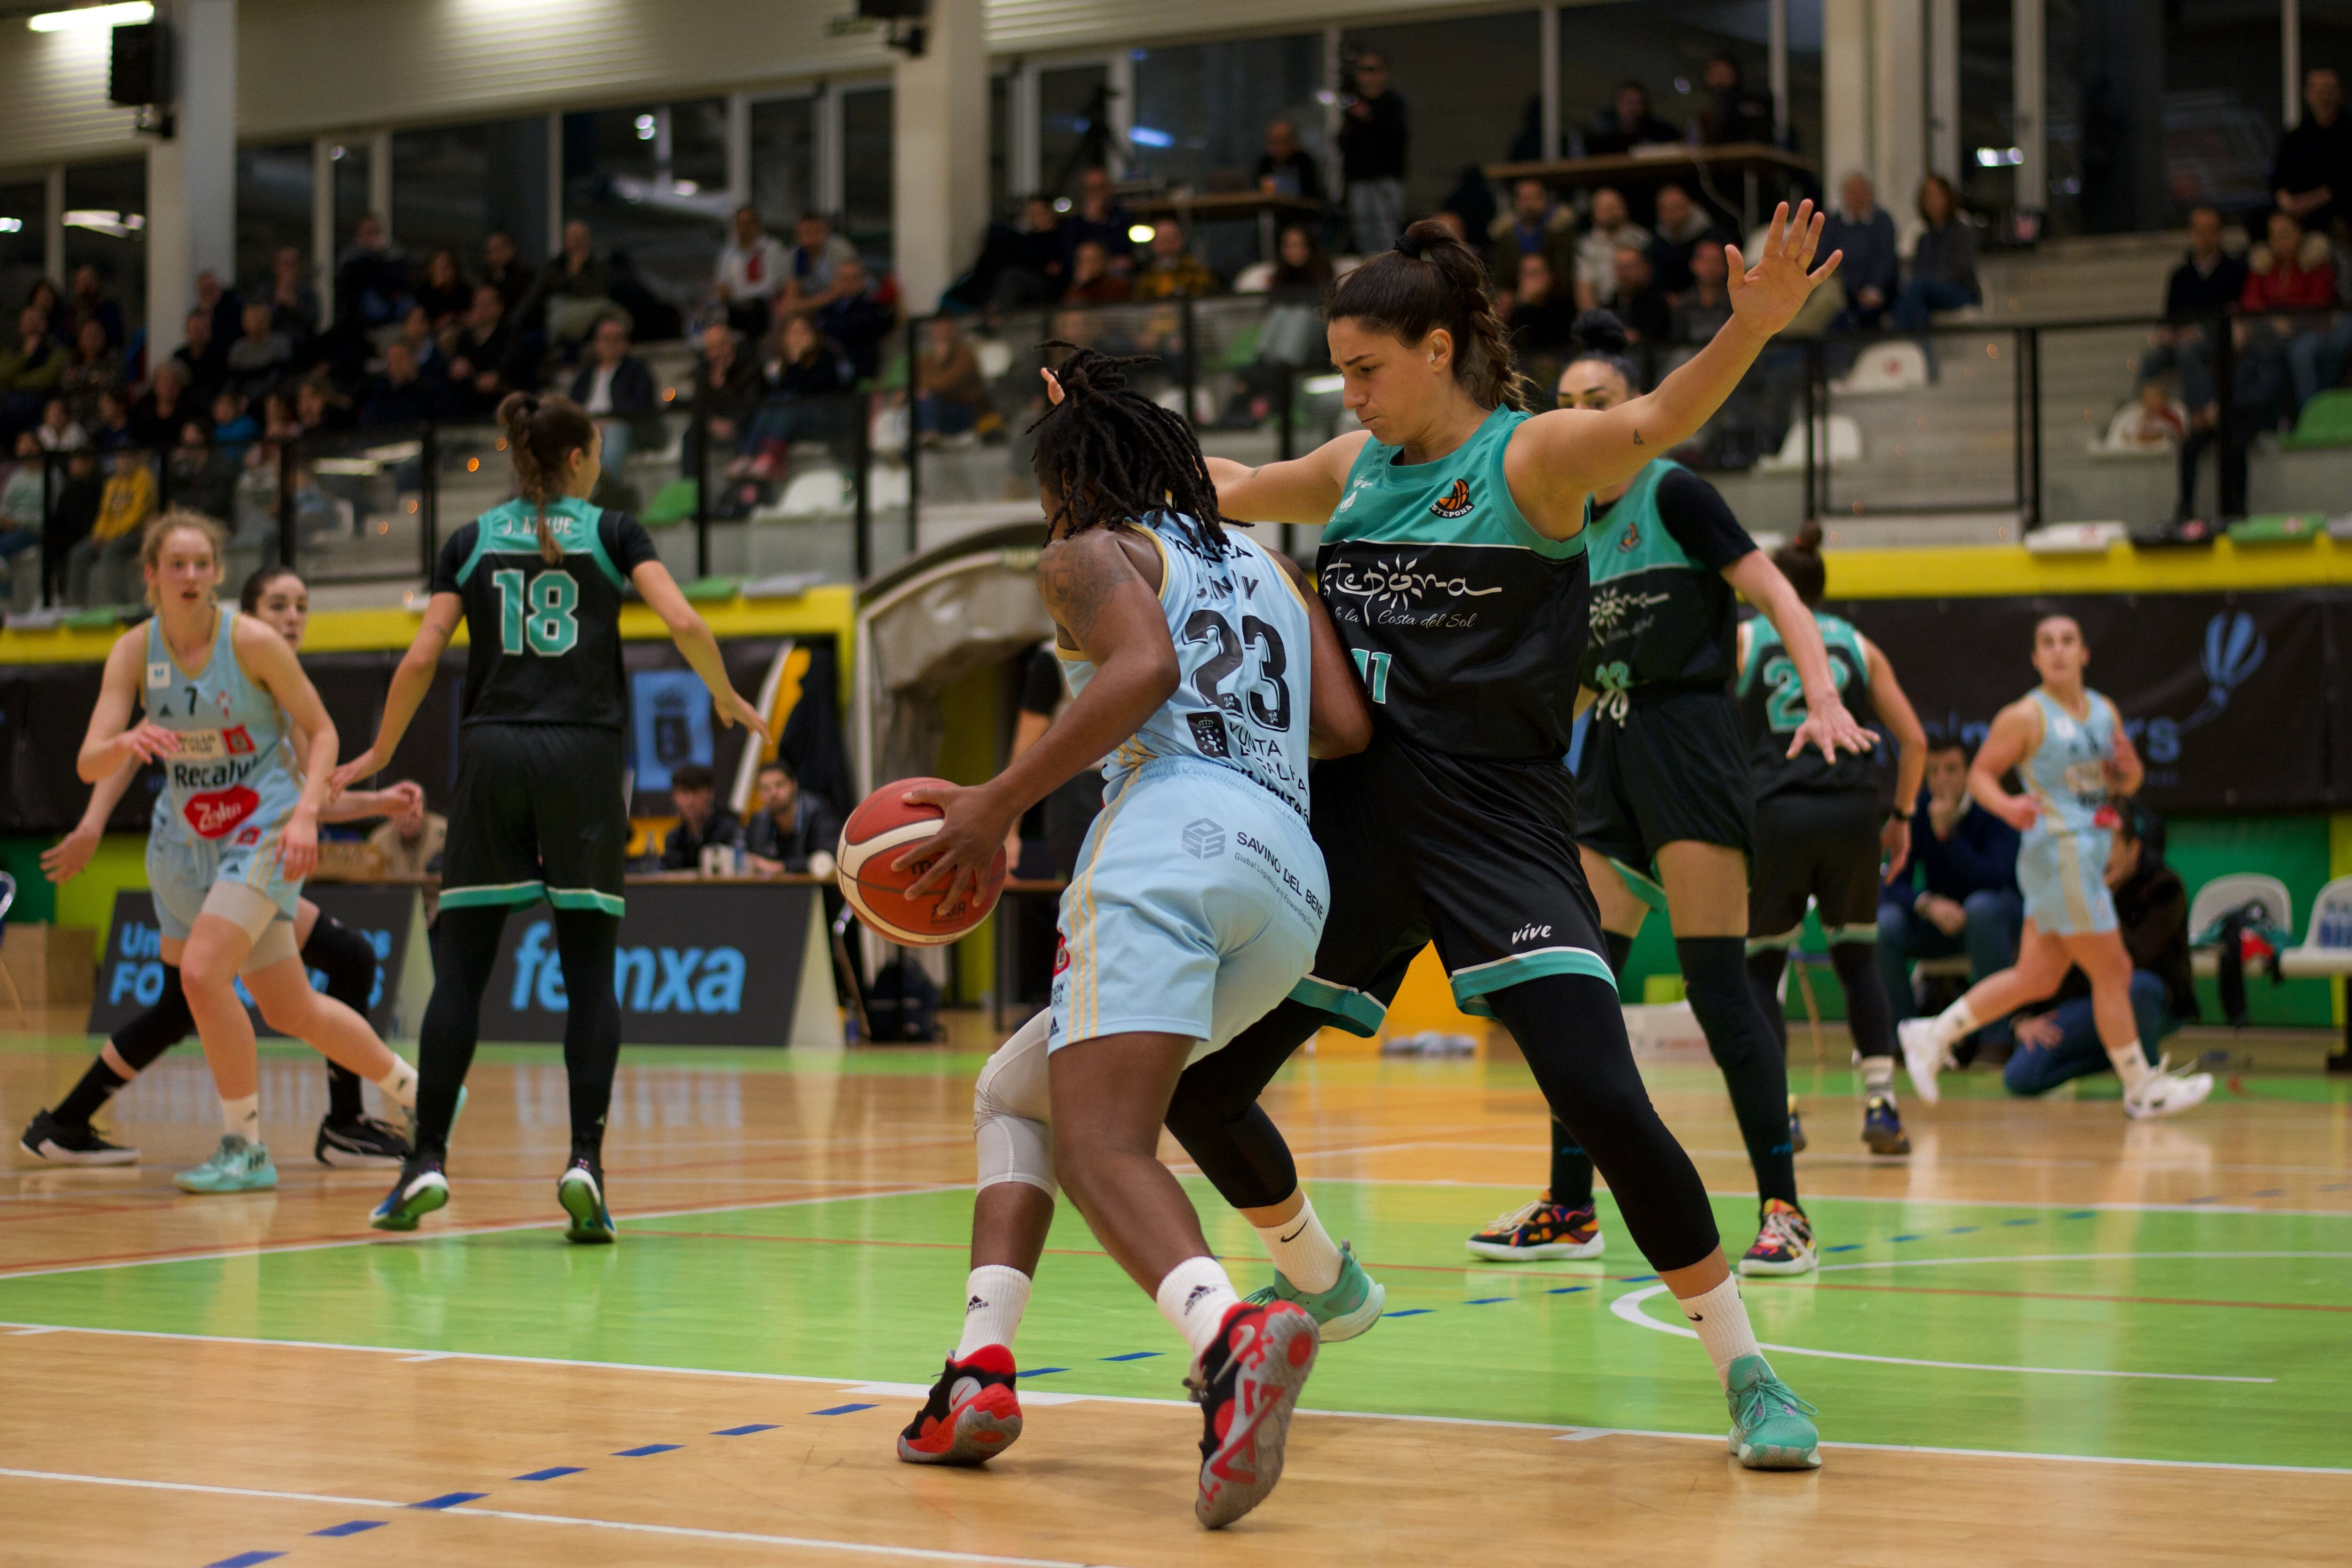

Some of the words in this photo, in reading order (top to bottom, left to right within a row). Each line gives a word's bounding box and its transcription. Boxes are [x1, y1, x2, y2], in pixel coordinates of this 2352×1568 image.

[523, 516, 574, 534] AUE
[492, 568, 579, 656] 18
[1345, 609, 1361, 623] la
[1378, 610, 1418, 625] Costa
[1420, 613, 1447, 628] del
[1446, 613, 1477, 627] Sol
[1181, 609, 1290, 732] 23
[185, 686, 198, 716] 7
[1235, 852, 1256, 869] Global
[1237, 831, 1281, 873] SAVINO
[1283, 868, 1302, 896] DEL
[1512, 923, 1551, 945] vive
